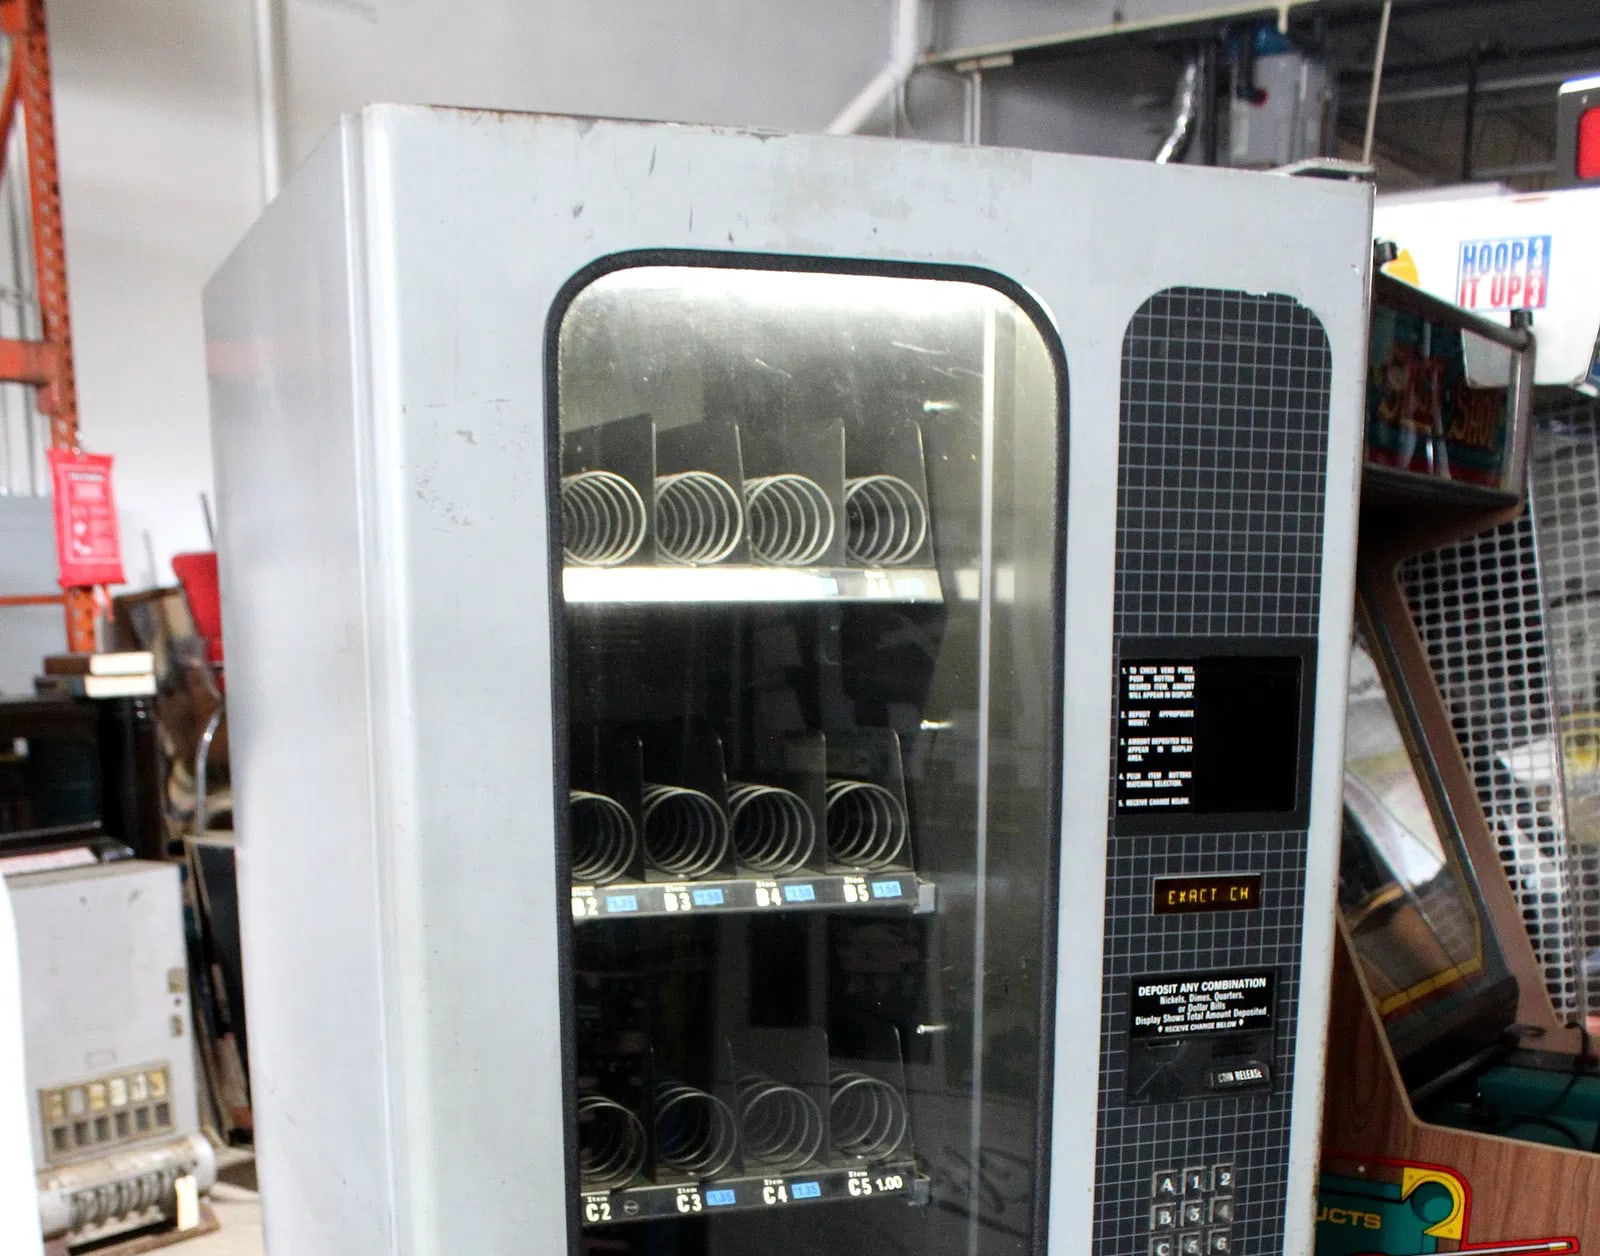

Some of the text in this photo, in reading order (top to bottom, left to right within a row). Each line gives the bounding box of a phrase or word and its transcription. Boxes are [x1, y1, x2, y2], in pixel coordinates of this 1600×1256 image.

[1463, 241, 1525, 273] HOOP
[1460, 277, 1480, 309] IT
[1490, 276, 1522, 307] UP
[664, 893, 691, 912] B3
[755, 888, 782, 907] B4
[843, 884, 870, 903] B5
[1168, 887, 1249, 905] EXACT CH
[1138, 978, 1267, 997] DEPOSIT ANY COMBINATION
[1188, 1004, 1209, 1013] Dollar
[1210, 1002, 1226, 1011] Bills
[1135, 1016, 1161, 1026] Display
[1163, 1014, 1185, 1023] Shows
[1187, 1012, 1204, 1022] Total
[1206, 1011, 1231, 1020] Amount
[1165, 1025, 1189, 1033] RECEIVE
[1190, 1023, 1215, 1031] CHANGE
[1161, 1173, 1231, 1192] A 1 2
[586, 1203, 612, 1222] C2
[677, 1194, 702, 1213] C3
[763, 1186, 788, 1205] C4
[848, 1178, 872, 1197] C5
[876, 1175, 903, 1192] 1.00
[1160, 1211, 1172, 1225] B
[1190, 1207, 1200, 1221] 3
[1157, 1243, 1170, 1256] C
[1217, 1238, 1227, 1250] 6
